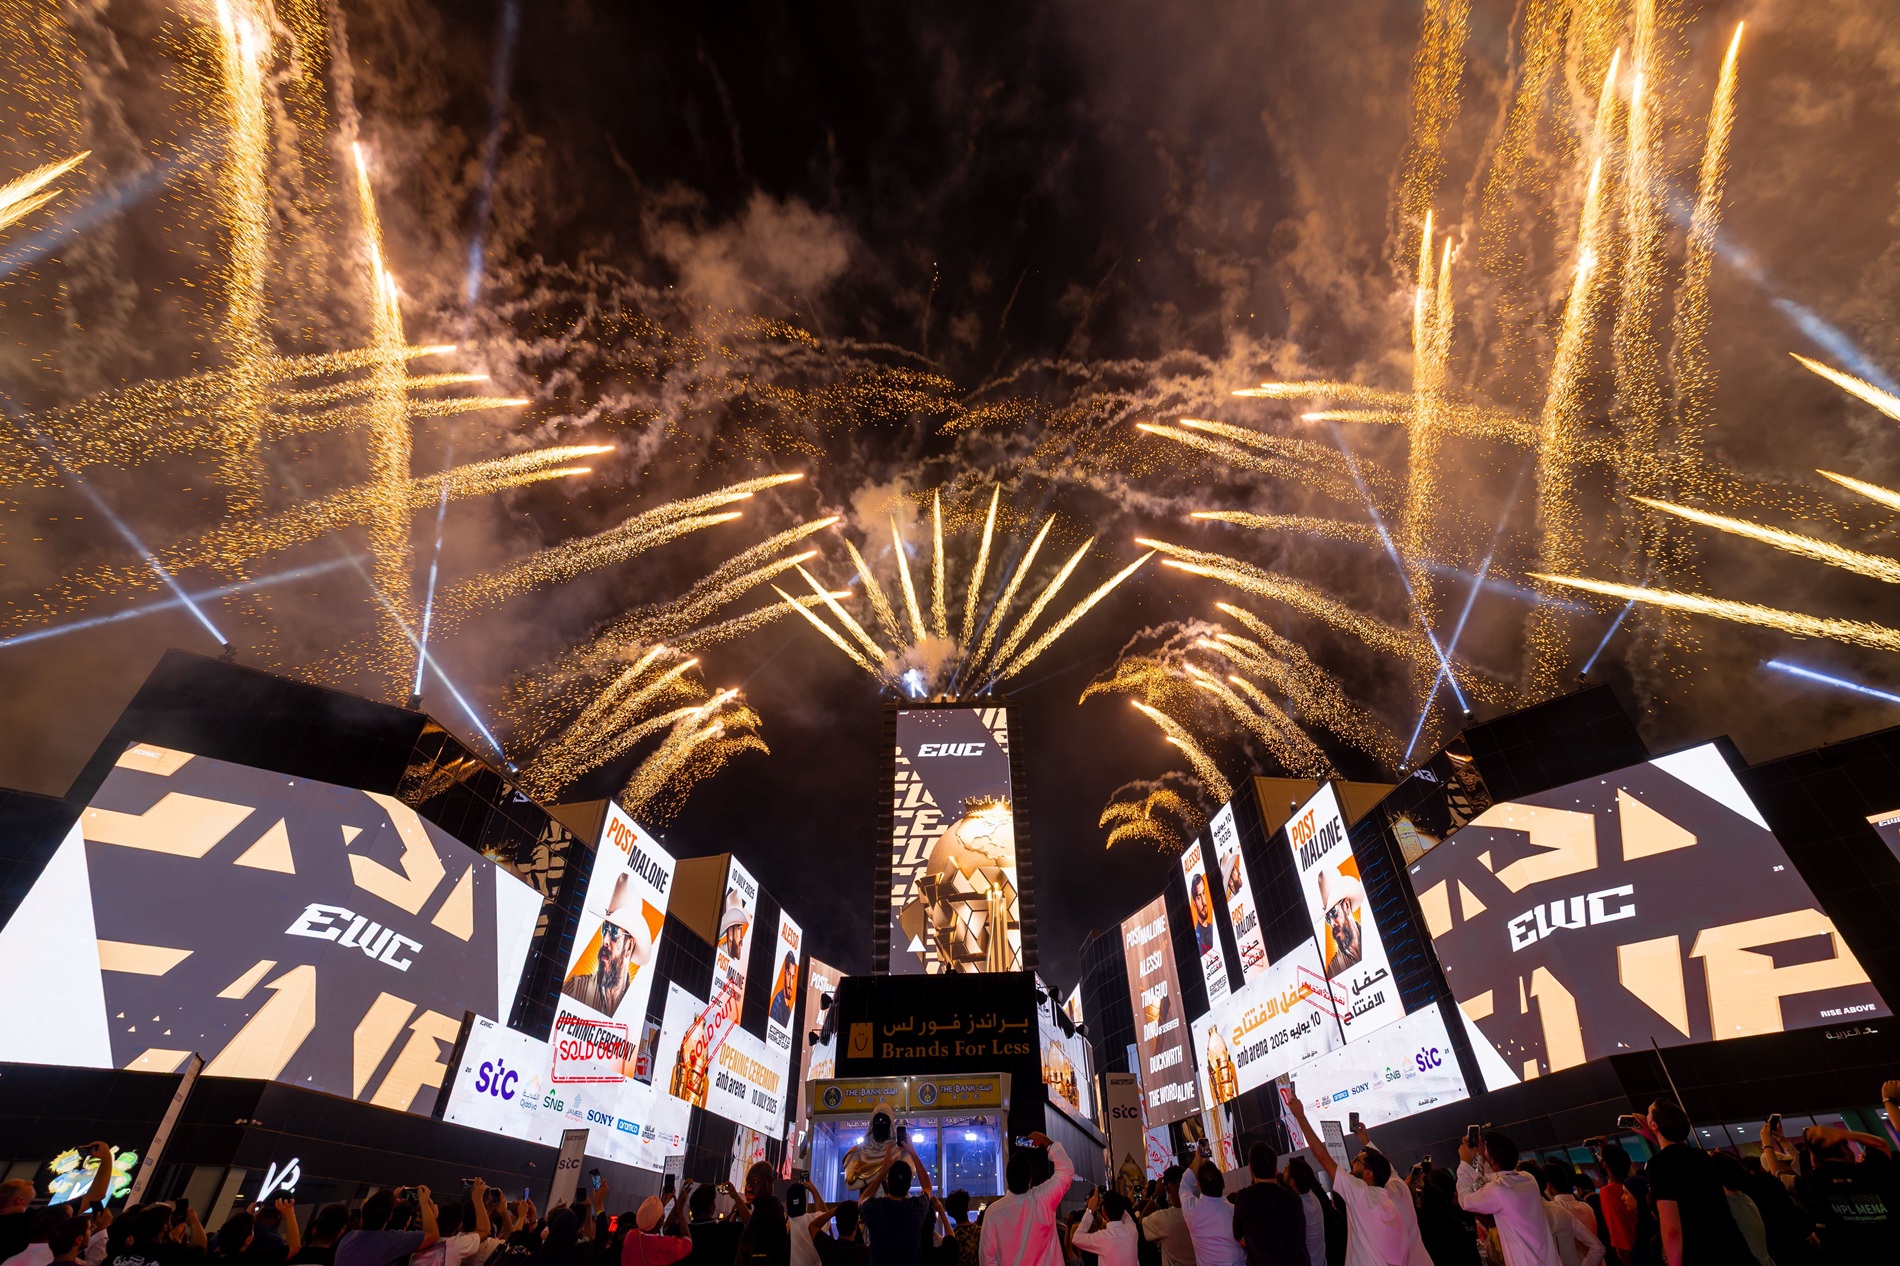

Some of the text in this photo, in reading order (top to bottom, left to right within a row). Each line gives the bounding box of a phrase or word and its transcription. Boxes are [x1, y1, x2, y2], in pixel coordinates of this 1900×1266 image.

[917, 742, 986, 758] EWC
[1225, 812, 1232, 825] 10
[1291, 808, 1317, 851] POST
[606, 816, 638, 856] POST
[1219, 828, 1232, 847] 2025
[1299, 814, 1343, 873] MALONE
[627, 844, 670, 895] MALONE
[1184, 845, 1201, 875] ALESSO
[1773, 864, 1784, 872] 25
[732, 868, 756, 900] 10 JULY 2025
[1231, 902, 1245, 928] POST
[1235, 910, 1257, 941] MALONE
[1507, 883, 1636, 953] EWC
[284, 903, 424, 972] EWC
[781, 922, 799, 951] ALESSO
[1126, 914, 1167, 950] POST MALONE
[716, 952, 730, 973] POST
[1139, 950, 1163, 979] ALESSO
[726, 965, 745, 991] MALONE
[810, 971, 829, 991] POST
[1351, 967, 1389, 997] حفل
[1141, 980, 1168, 1009] TINA GUO
[1232, 983, 1315, 1047] حفل الافتتاح
[1343, 990, 1386, 1027] الافتتاح
[1820, 1003, 1877, 1018] RISE ABOVE
[556, 1009, 637, 1062] OPENING CEREMONY
[689, 996, 733, 1068] SOLD OUT
[883, 1015, 913, 1037] لس
[917, 1013, 961, 1036] فور
[1143, 1019, 1159, 1042] DINO
[1269, 1010, 1322, 1050] 10 يوليو 2025
[559, 1039, 624, 1061] SOLD OUT
[881, 1038, 1031, 1059] Brands For Less
[1149, 1044, 1183, 1075] DUCKWRTH
[1236, 1038, 1269, 1069] anb arena
[1415, 1046, 1442, 1073] stc
[475, 1058, 519, 1101] stc
[719, 1042, 750, 1079] OPENING
[747, 1059, 781, 1095] CEREMONY
[1385, 1069, 1402, 1083] SNB
[715, 1070, 747, 1100] anb arena
[845, 1089, 859, 1097] THE
[940, 1085, 953, 1093] THE
[1148, 1080, 1195, 1109] THE WORD ALIVE
[1351, 1081, 1370, 1096] SONY
[542, 1096, 565, 1112] SNB
[751, 1088, 778, 1115] 10 JULY 2025
[1112, 1104, 1139, 1119] stc
[587, 1109, 615, 1127] SONY
[618, 1121, 639, 1134] aramco
[558, 1157, 580, 1170] stc
[1831, 1203, 1889, 1215] MPL MENA
